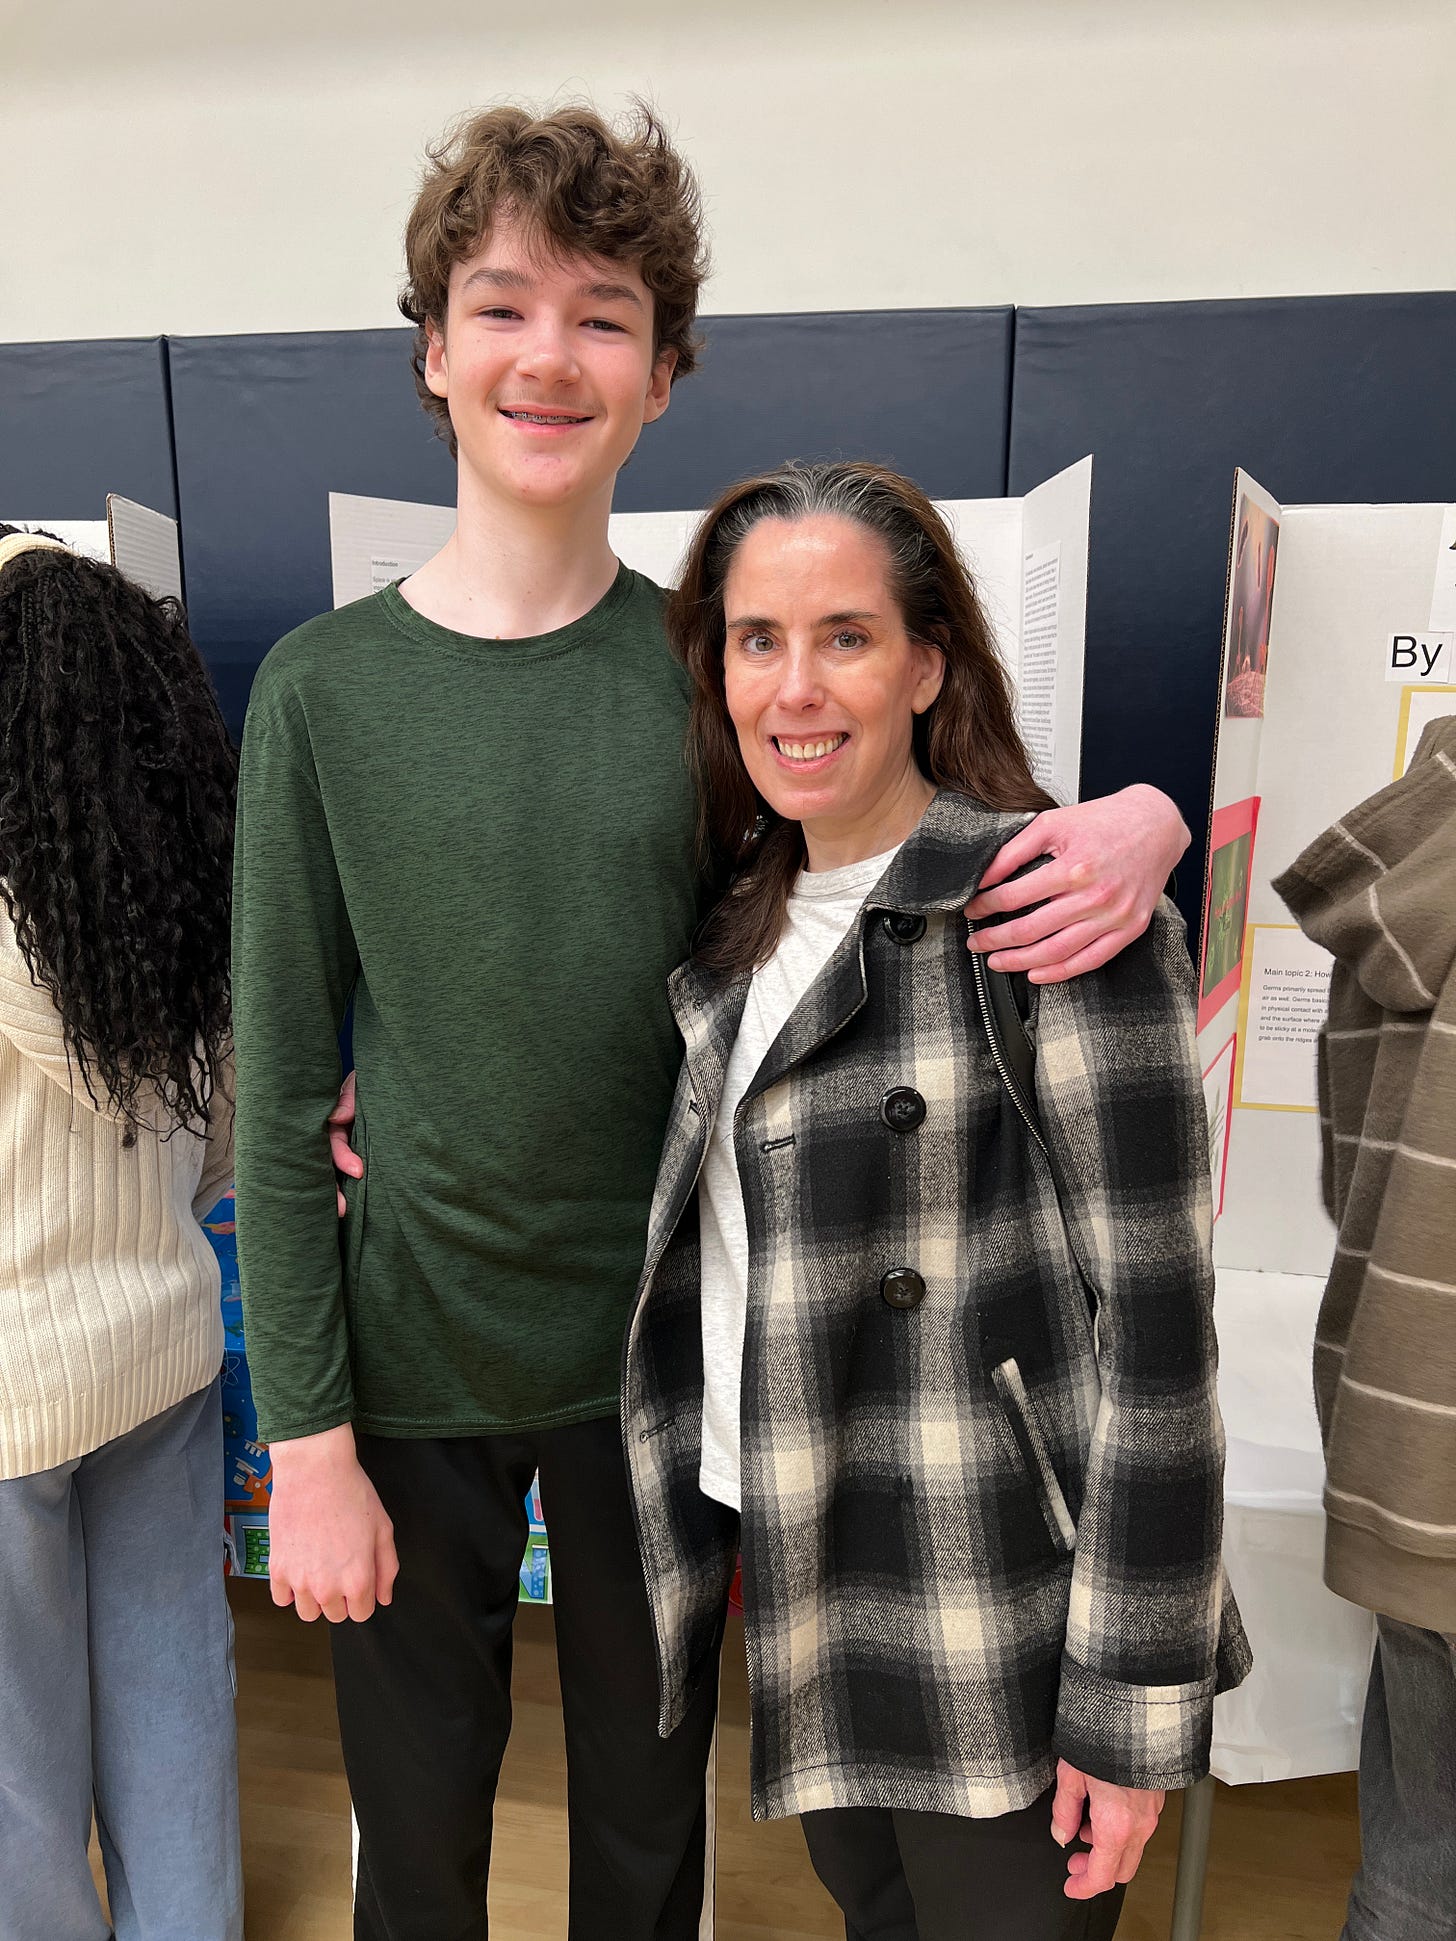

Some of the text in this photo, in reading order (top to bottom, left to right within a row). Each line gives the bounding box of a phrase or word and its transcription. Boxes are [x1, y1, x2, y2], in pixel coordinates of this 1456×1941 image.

[1391, 636, 1443, 677] By
[1264, 968, 1283, 976] Main
[1285, 969, 1304, 978] topic
[1314, 970, 1332, 978] How
